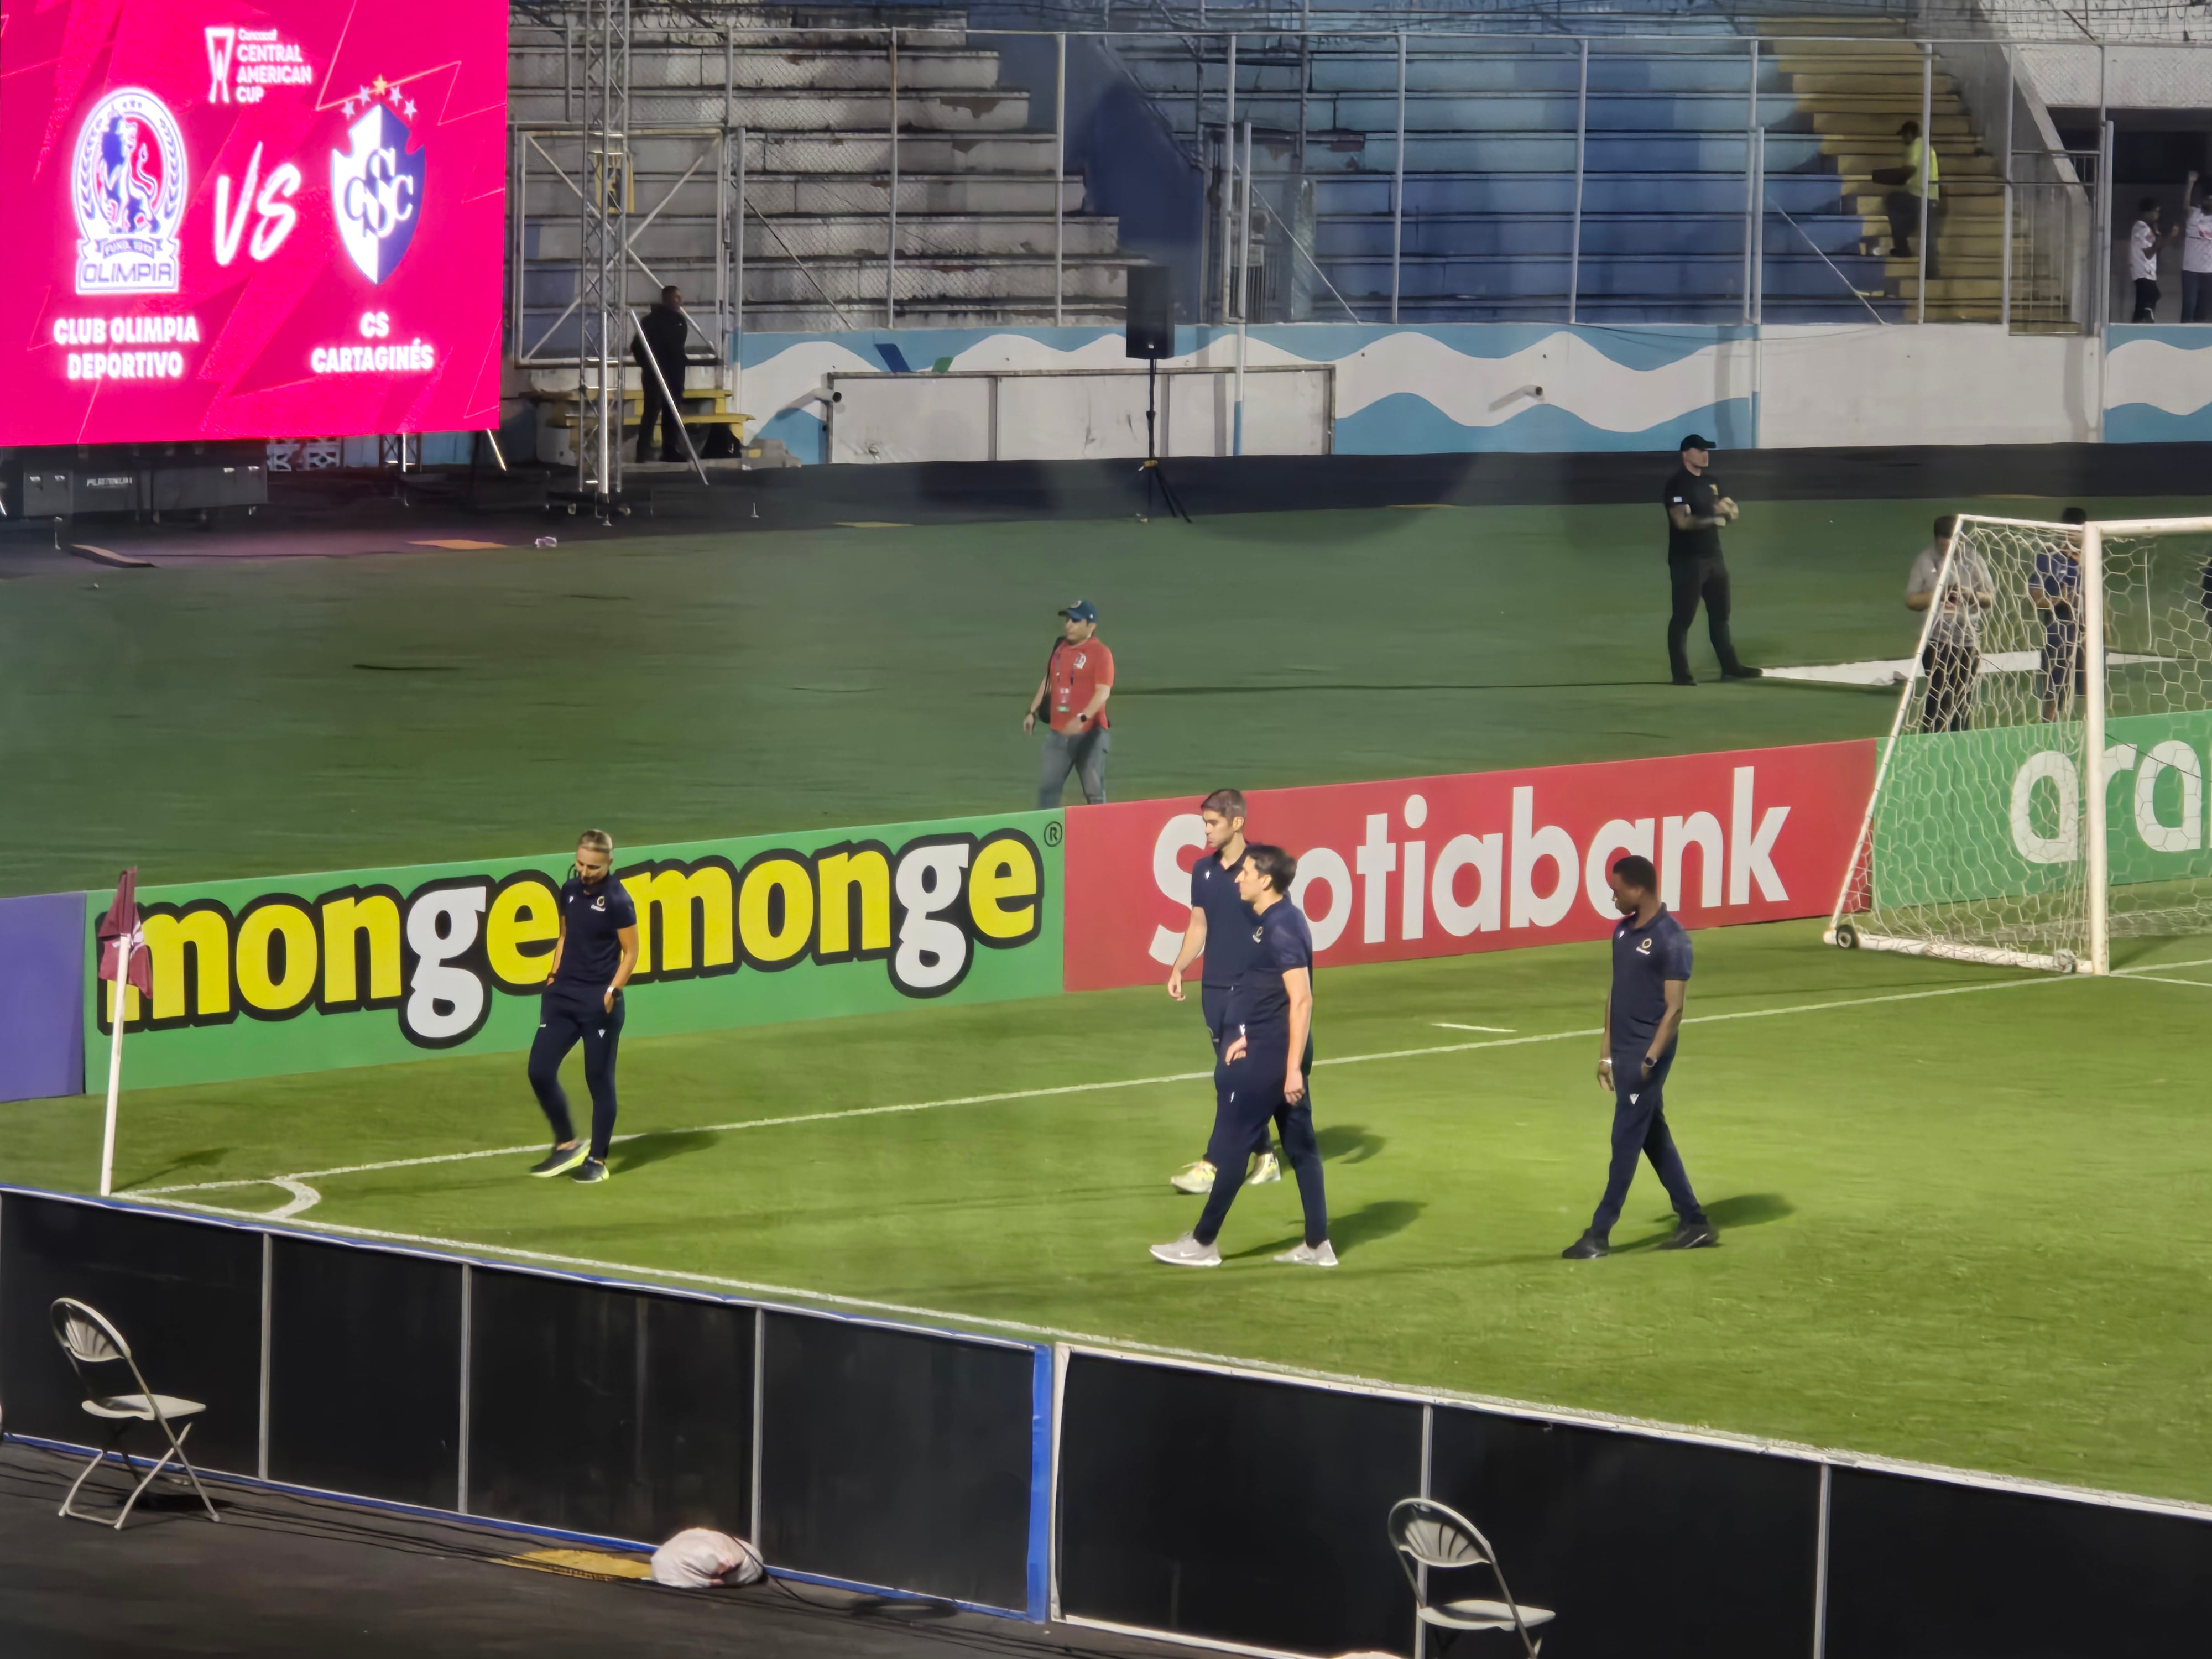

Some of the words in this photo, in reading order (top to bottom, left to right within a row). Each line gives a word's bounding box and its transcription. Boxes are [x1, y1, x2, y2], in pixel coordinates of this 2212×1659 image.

[237, 43, 303, 64] CENTRAL
[236, 65, 312, 84] AMERICAN
[236, 85, 264, 103] CUP
[212, 140, 301, 266] VS
[84, 263, 173, 283] OLIMPIA
[53, 317, 107, 345] CLUB
[110, 316, 200, 343] OLIMPIA
[360, 311, 389, 339] CS
[67, 350, 184, 380] DEPORTIVO
[311, 338, 435, 373] CARTAGINÉS
[1149, 766, 1791, 966] Sotiabank
[98, 870, 560, 1048] monge
[616, 828, 1044, 999] monge
